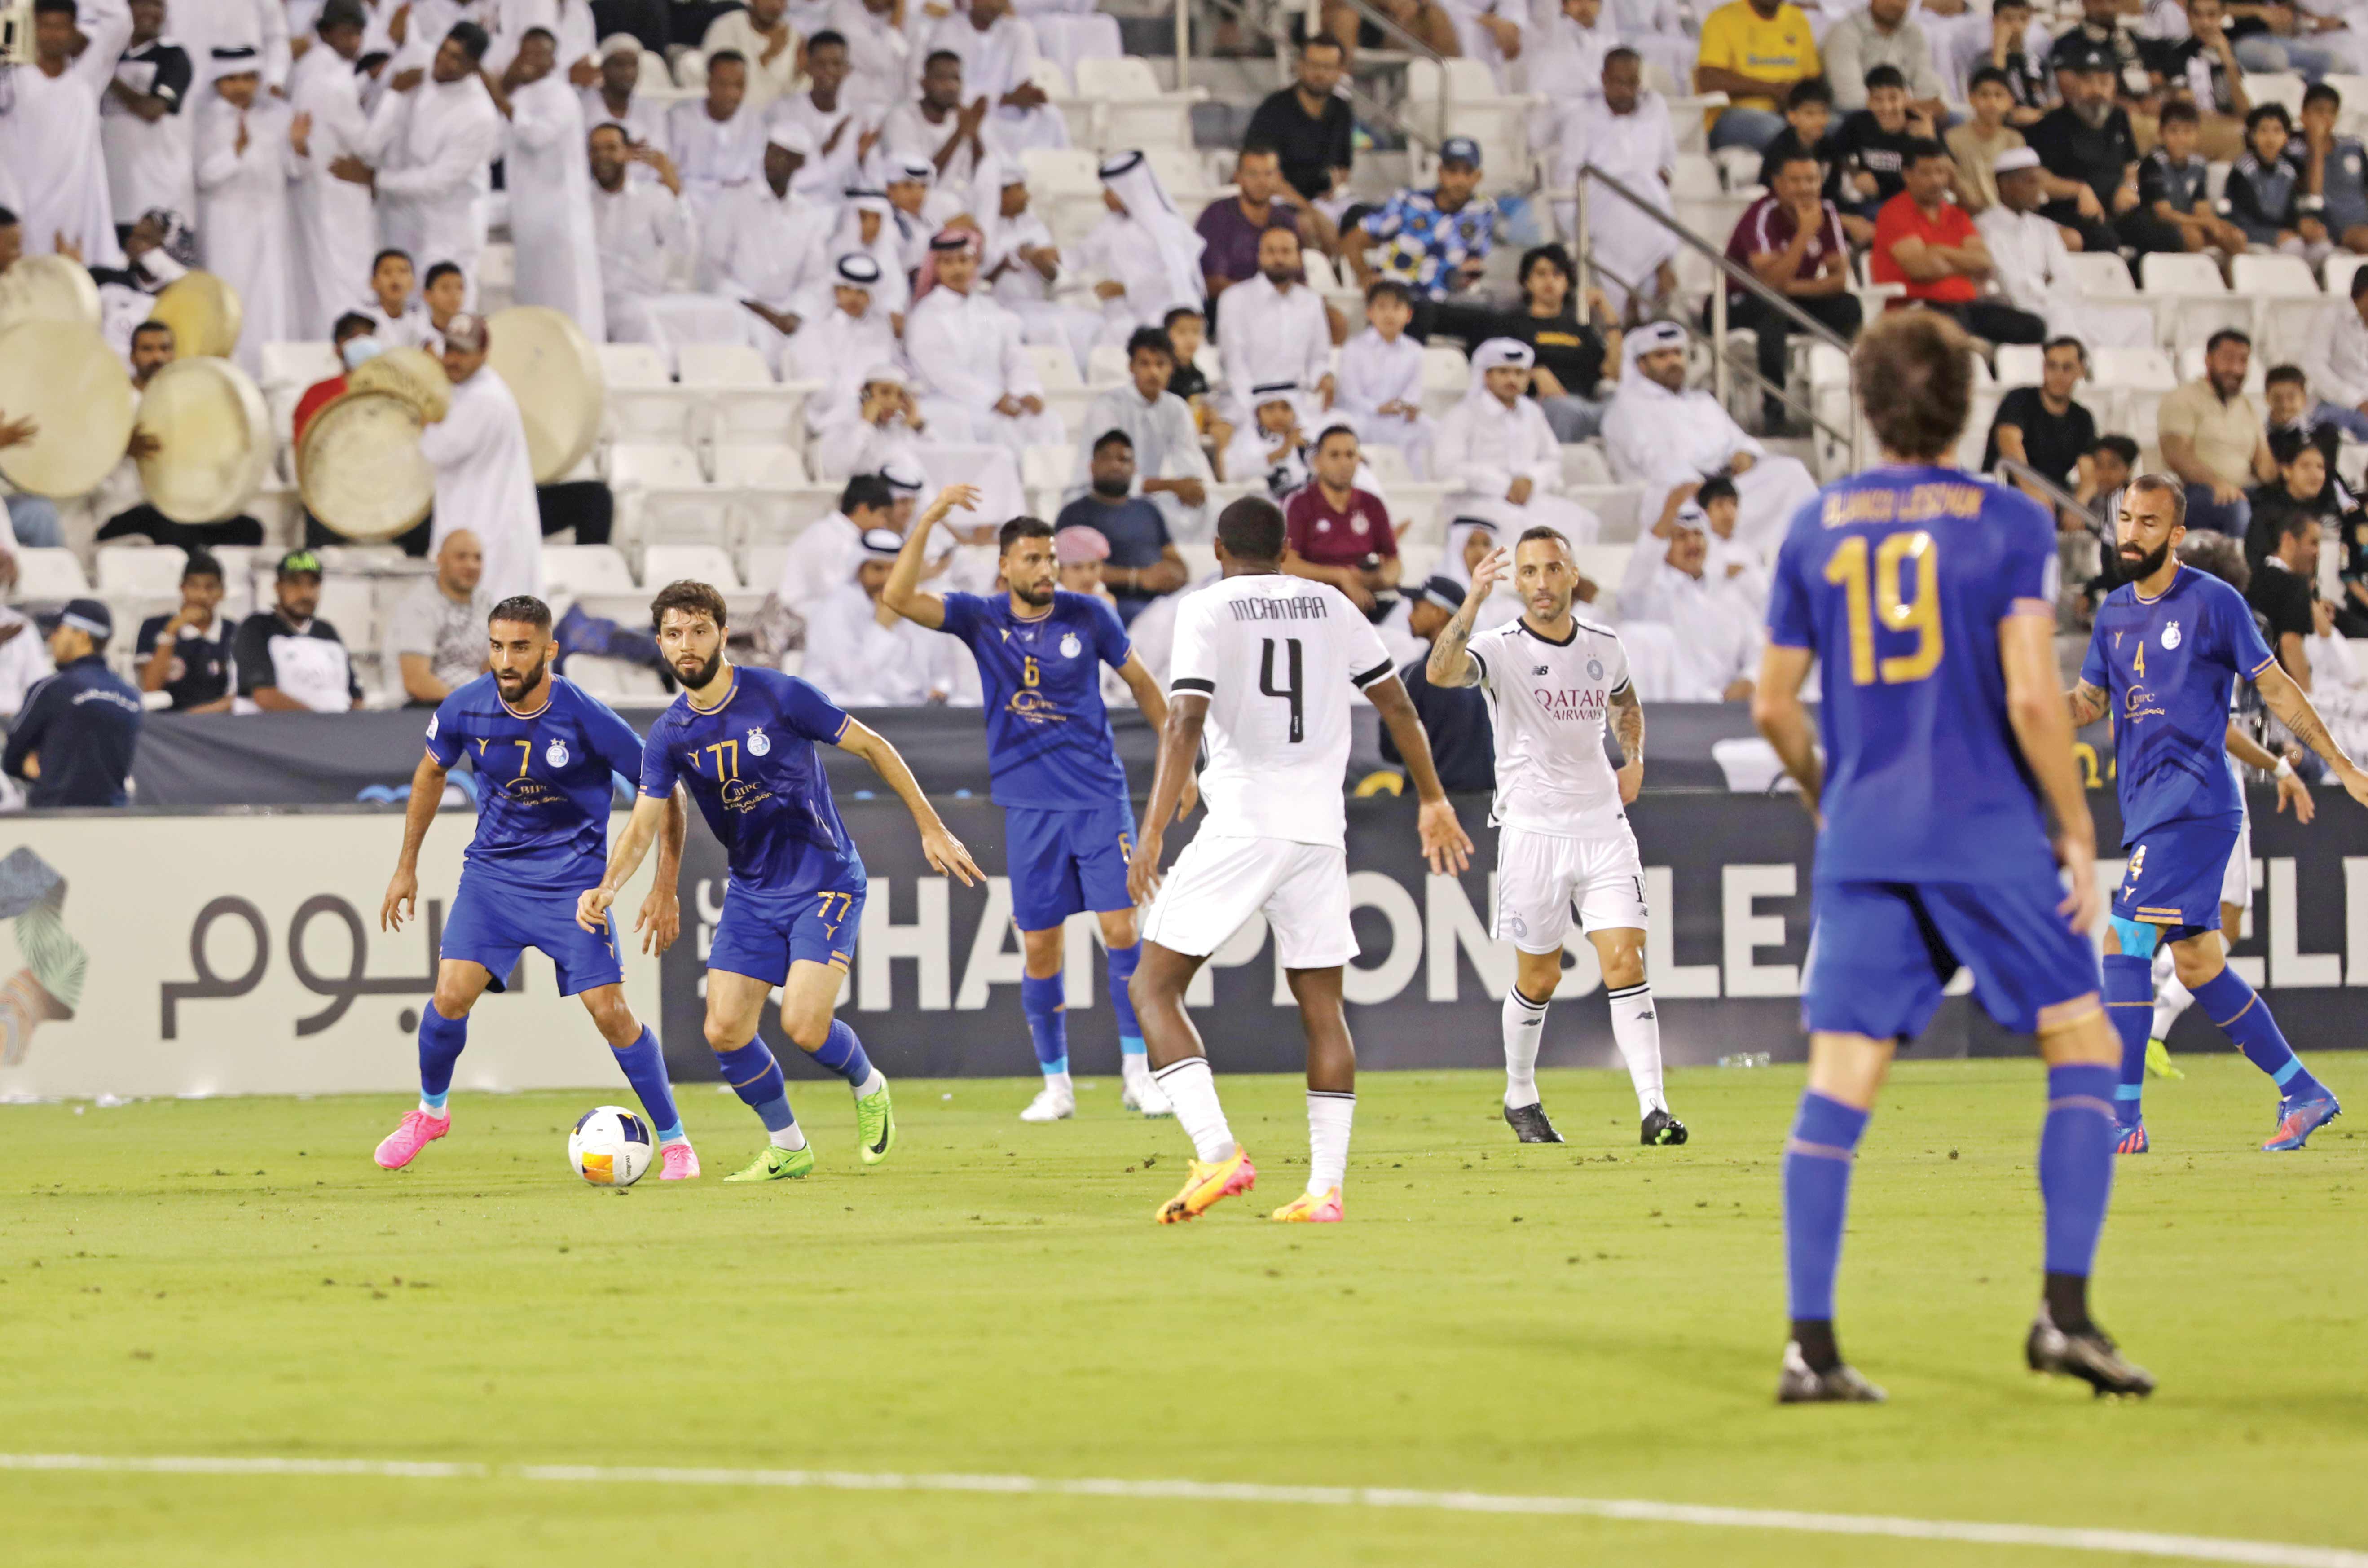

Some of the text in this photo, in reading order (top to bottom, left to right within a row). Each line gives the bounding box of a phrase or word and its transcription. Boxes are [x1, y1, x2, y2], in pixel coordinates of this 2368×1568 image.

[1823, 531, 1945, 686] 19
[1024, 655, 1040, 688] 6
[2133, 640, 2145, 678] 4
[1259, 637, 1303, 743] 4
[1534, 689, 1605, 711] QATAR
[515, 740, 532, 777] 7
[706, 739, 739, 782] 77
[733, 781, 761, 796] BIPC
[1118, 832, 1132, 865] 6
[2128, 844, 2147, 881] 4
[817, 891, 852, 922] 77
[769, 870, 1604, 1013] HAONS
[161, 893, 524, 1039] يوم
